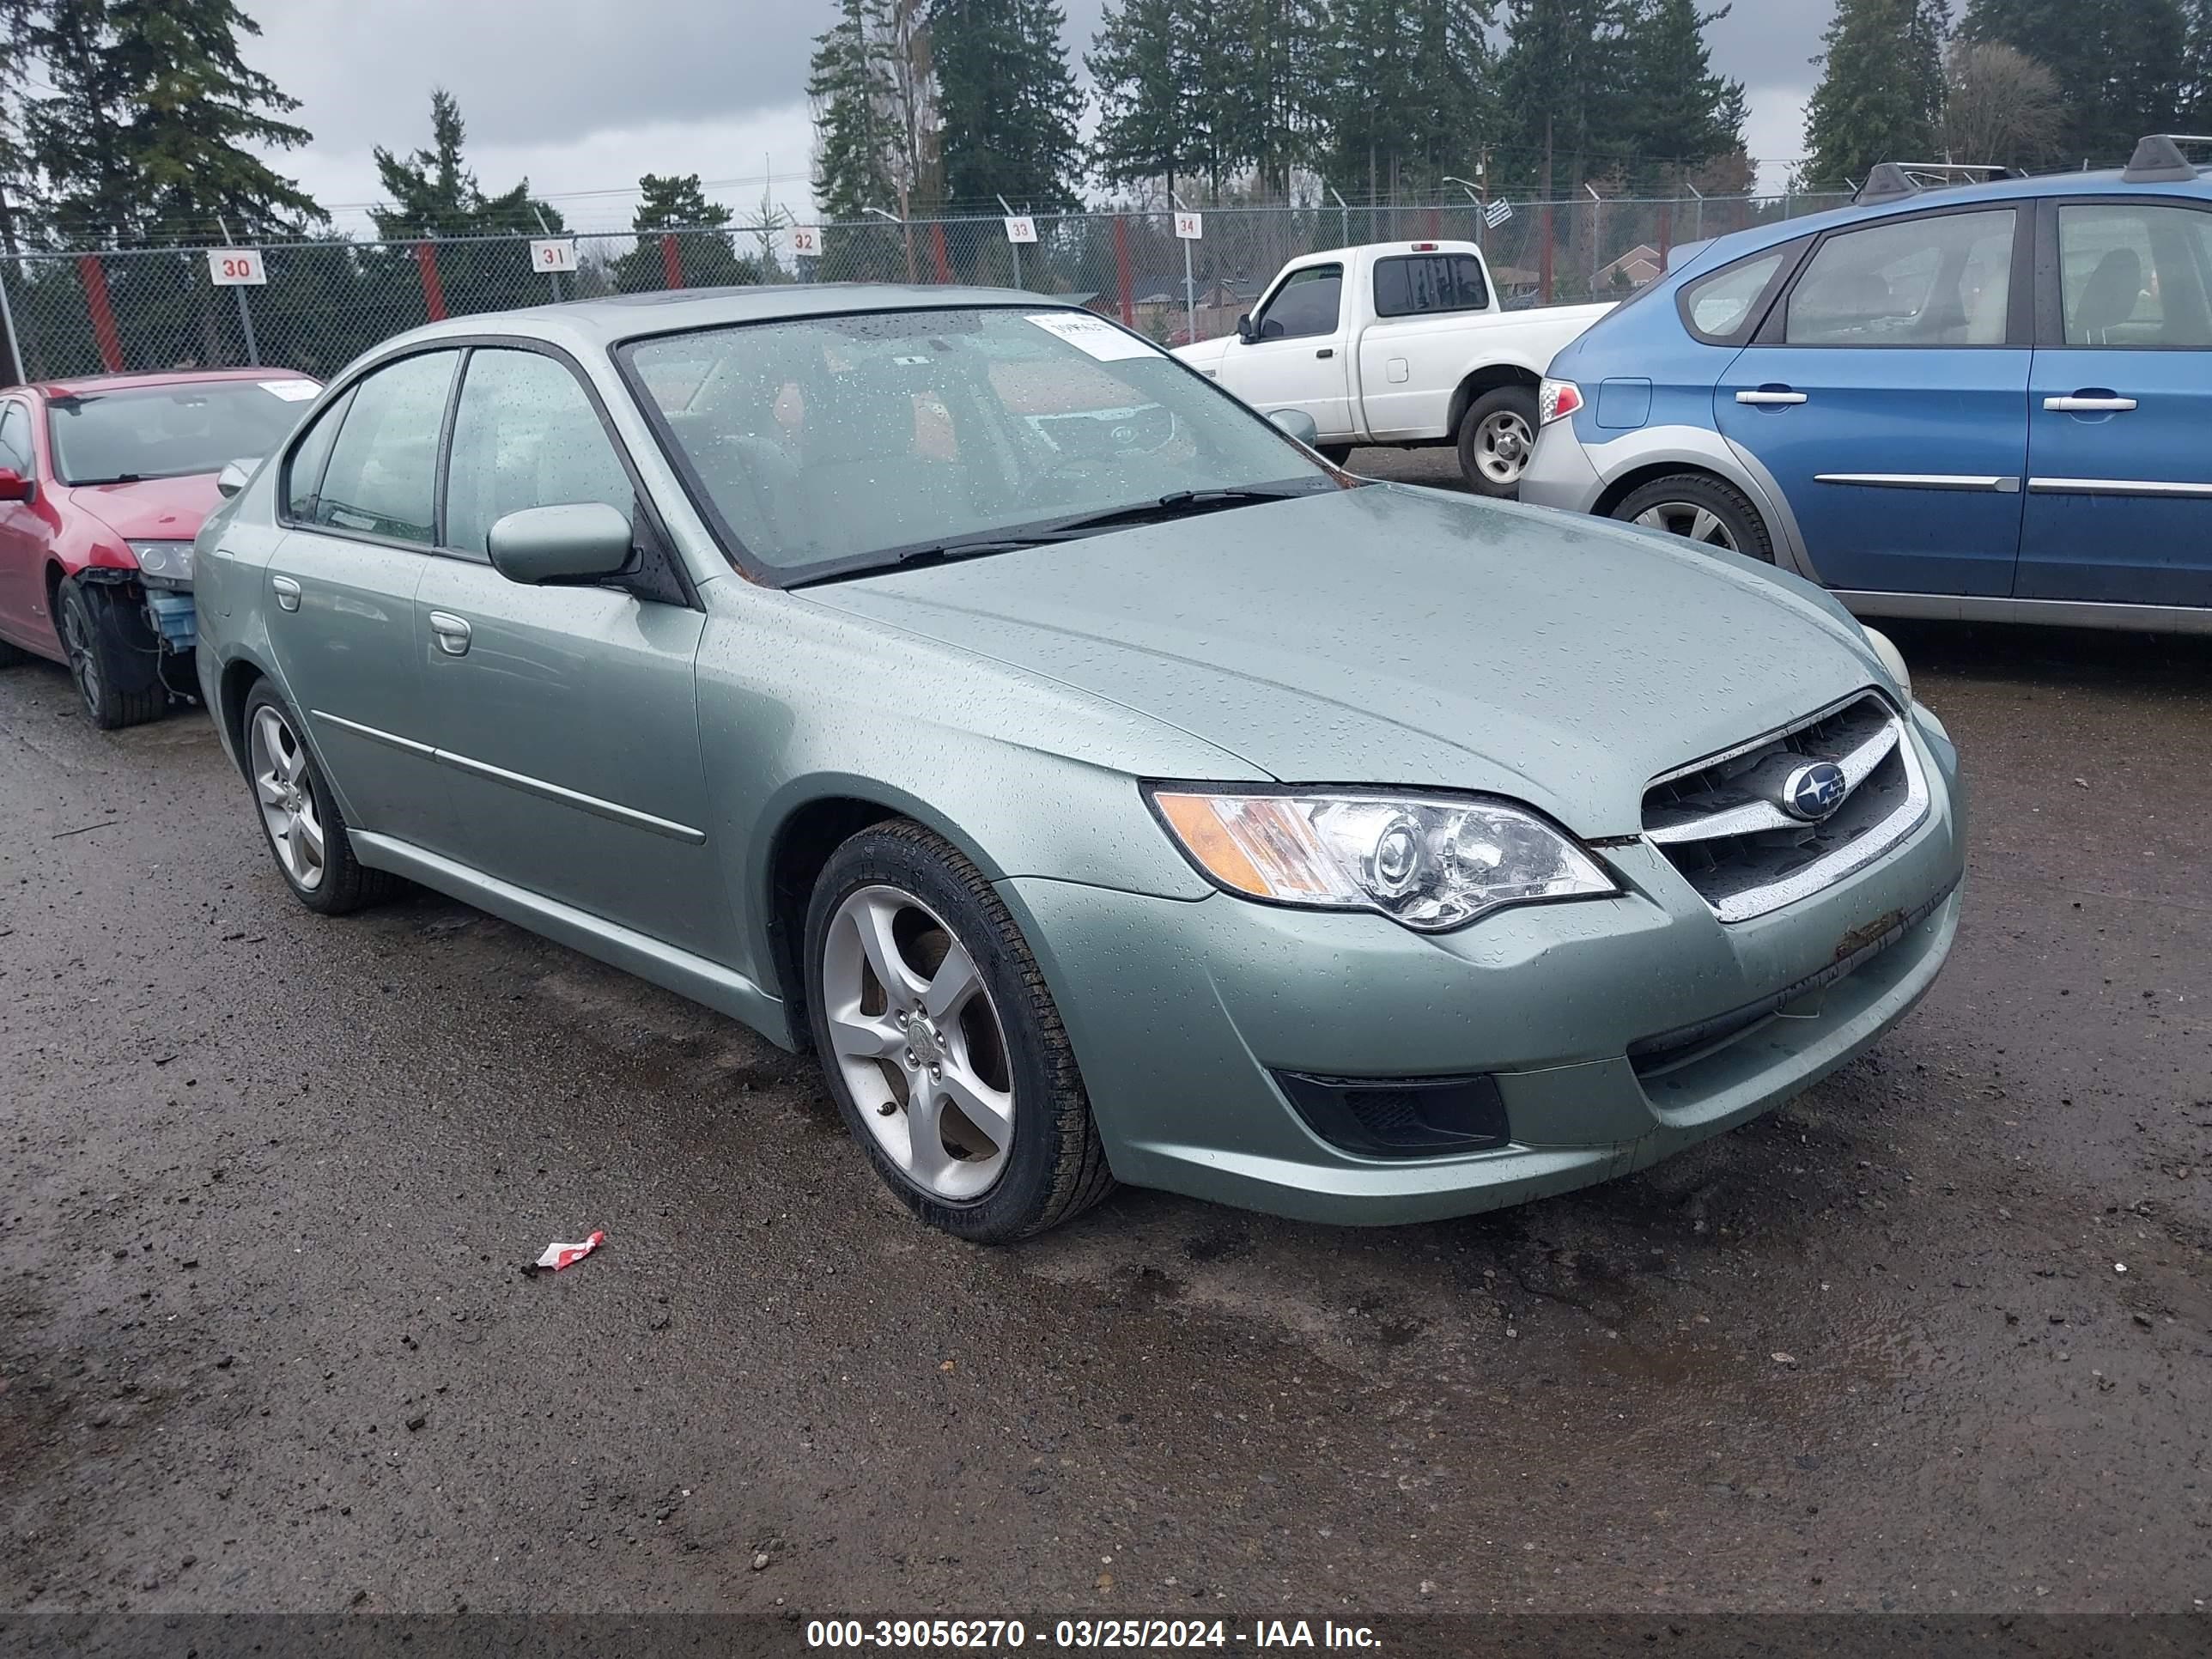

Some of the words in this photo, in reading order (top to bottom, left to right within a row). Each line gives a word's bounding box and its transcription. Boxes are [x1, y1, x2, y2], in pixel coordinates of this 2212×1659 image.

[1012, 224, 1029, 237] 33
[1181, 220, 1194, 233] 34
[794, 234, 813, 249] 32
[543, 249, 564, 264] 31
[223, 259, 251, 277] 30
